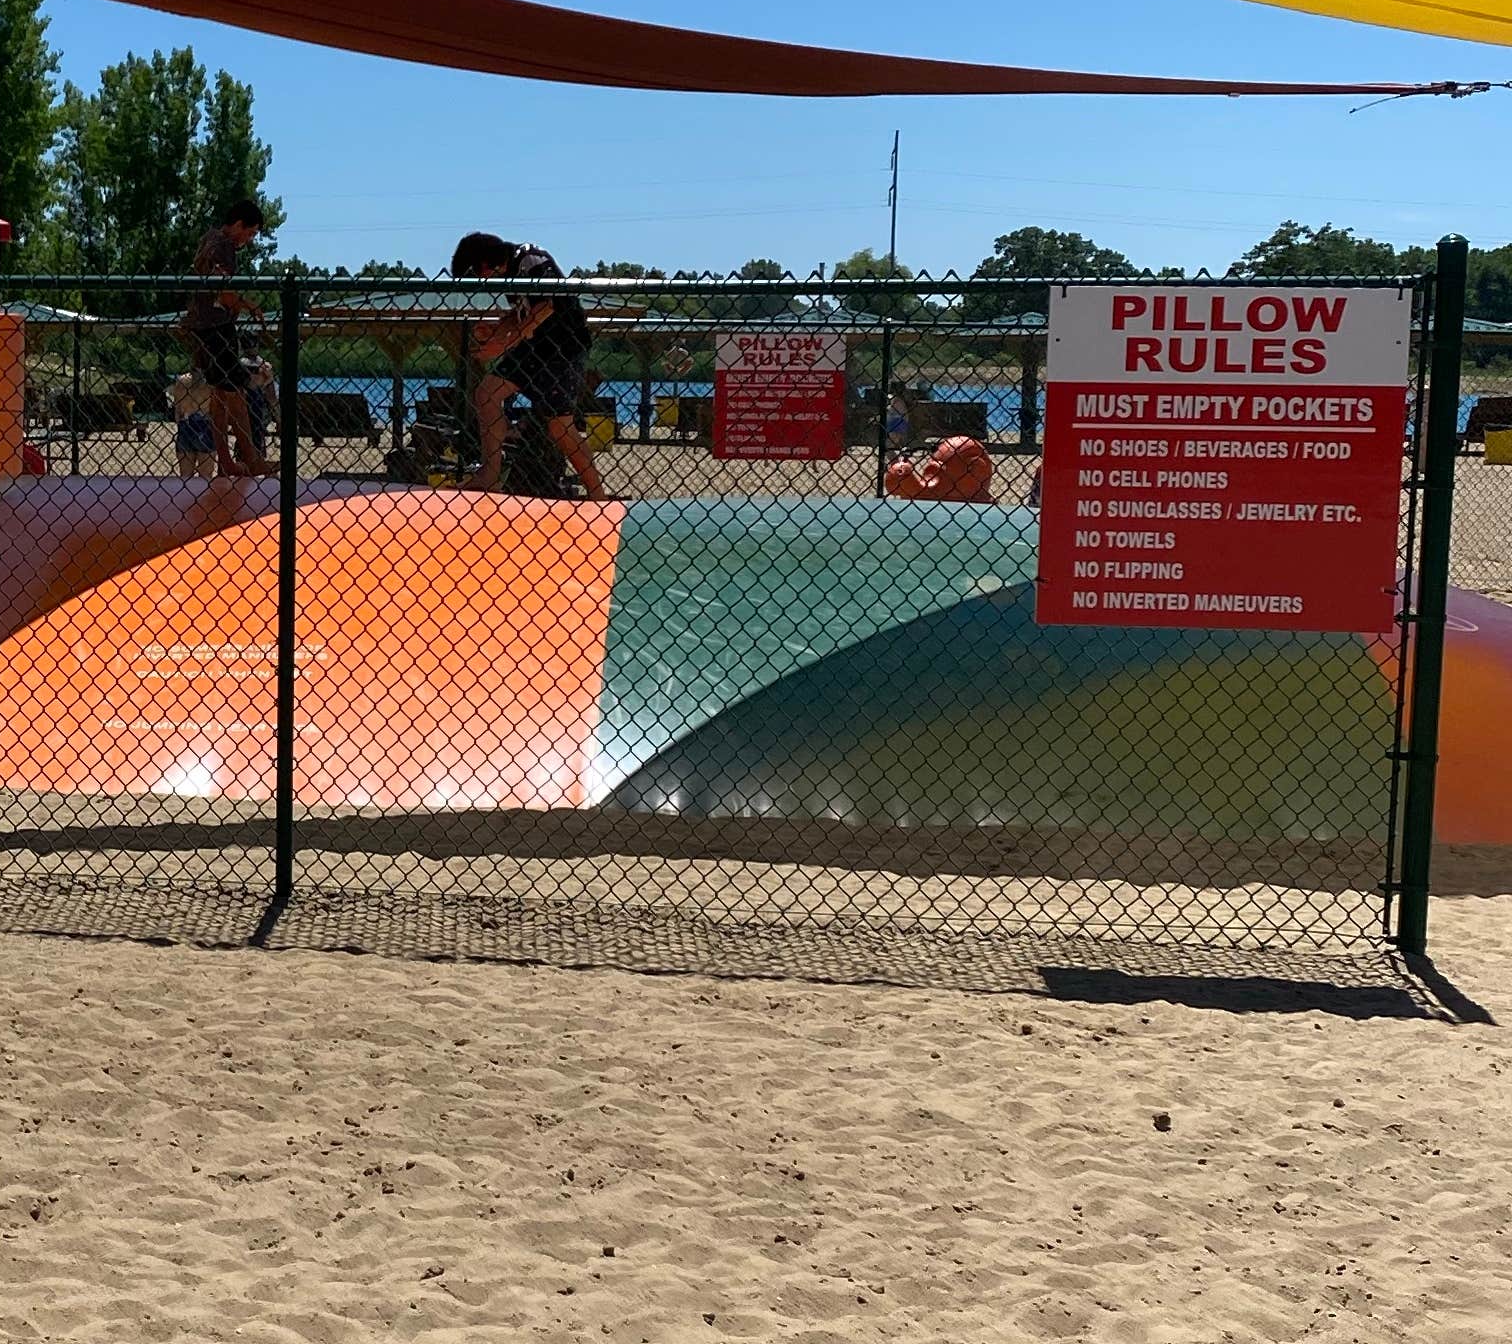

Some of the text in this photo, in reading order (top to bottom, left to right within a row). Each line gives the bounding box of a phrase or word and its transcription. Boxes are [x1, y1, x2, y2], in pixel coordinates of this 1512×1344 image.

[1111, 295, 1348, 333] PILLOW
[738, 338, 824, 351] PILLOW
[743, 353, 817, 367] RULES
[1124, 337, 1328, 375] RULES
[1075, 394, 1374, 422] MUST EMPTY POCKETS
[1079, 439, 1352, 459] NO SHOES / BEVERAGES / FOOD
[1078, 470, 1229, 489] NO CELL PHONES
[1077, 500, 1362, 523] NO SUNGLASSES / JEWELRY ETC.
[1075, 531, 1176, 549] NO TOWELS
[1073, 561, 1184, 580] NO FLIPPING
[1072, 592, 1304, 614] NO INVERTED MANEUVERS
